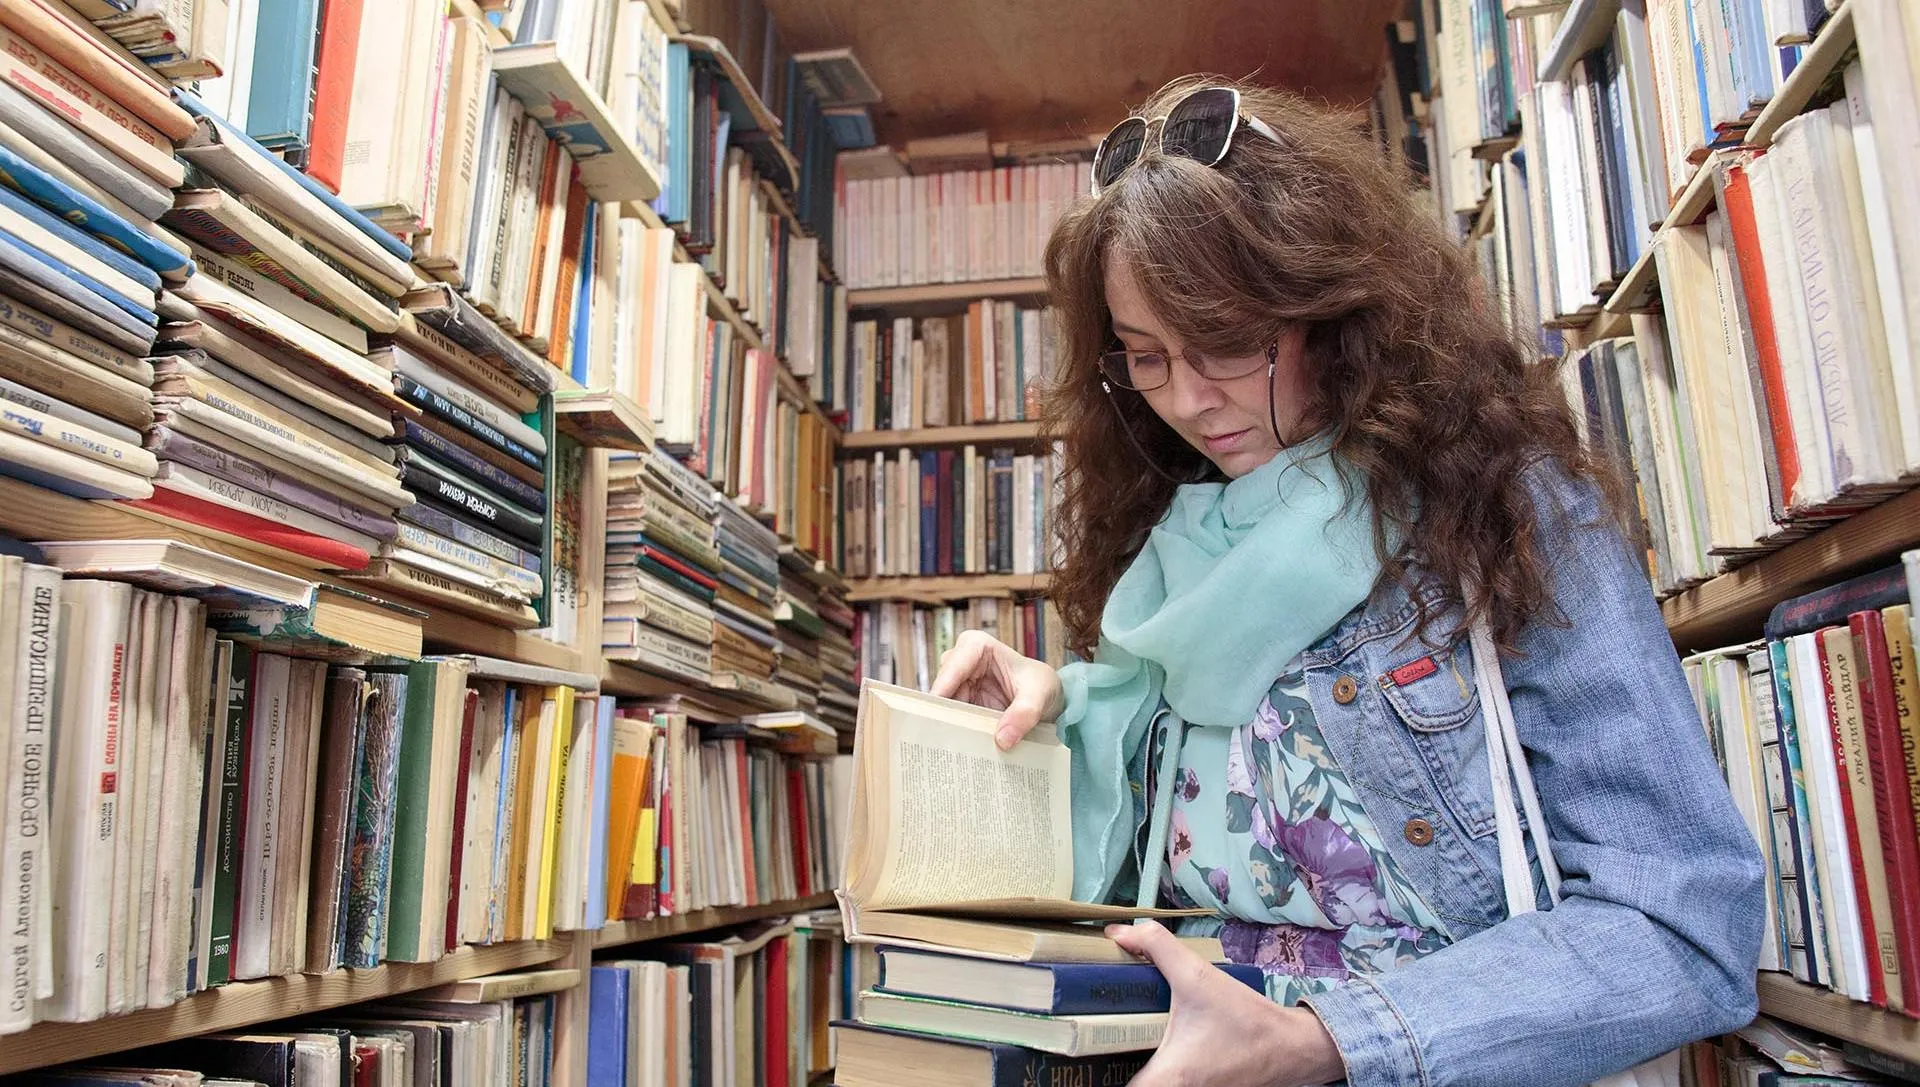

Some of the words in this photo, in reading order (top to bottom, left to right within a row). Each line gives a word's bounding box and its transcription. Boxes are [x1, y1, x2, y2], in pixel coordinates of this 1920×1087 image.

[107, 107, 129, 128] ПРО
[131, 123, 156, 146] СЕБЯ
[416, 323, 456, 356] ШКОЛА
[249, 494, 273, 513] ДОМ
[408, 568, 451, 591] ШКОЛА
[27, 586, 53, 735] ПРЕДПИСАНИЕ
[1837, 653, 1857, 713] ГАЙДАР
[105, 722, 118, 764] СЛОНЫ
[1848, 715, 1867, 786] АРКАДИЙ
[21, 743, 44, 839] СРОЧНОЕ
[556, 775, 566, 825] ПАРОЛЬ
[223, 791, 234, 873] ДОСТОИНСТВО
[16, 850, 33, 938] Алексеев
[213, 943, 229, 956] 1980
[12, 945, 30, 1013] Сергей
